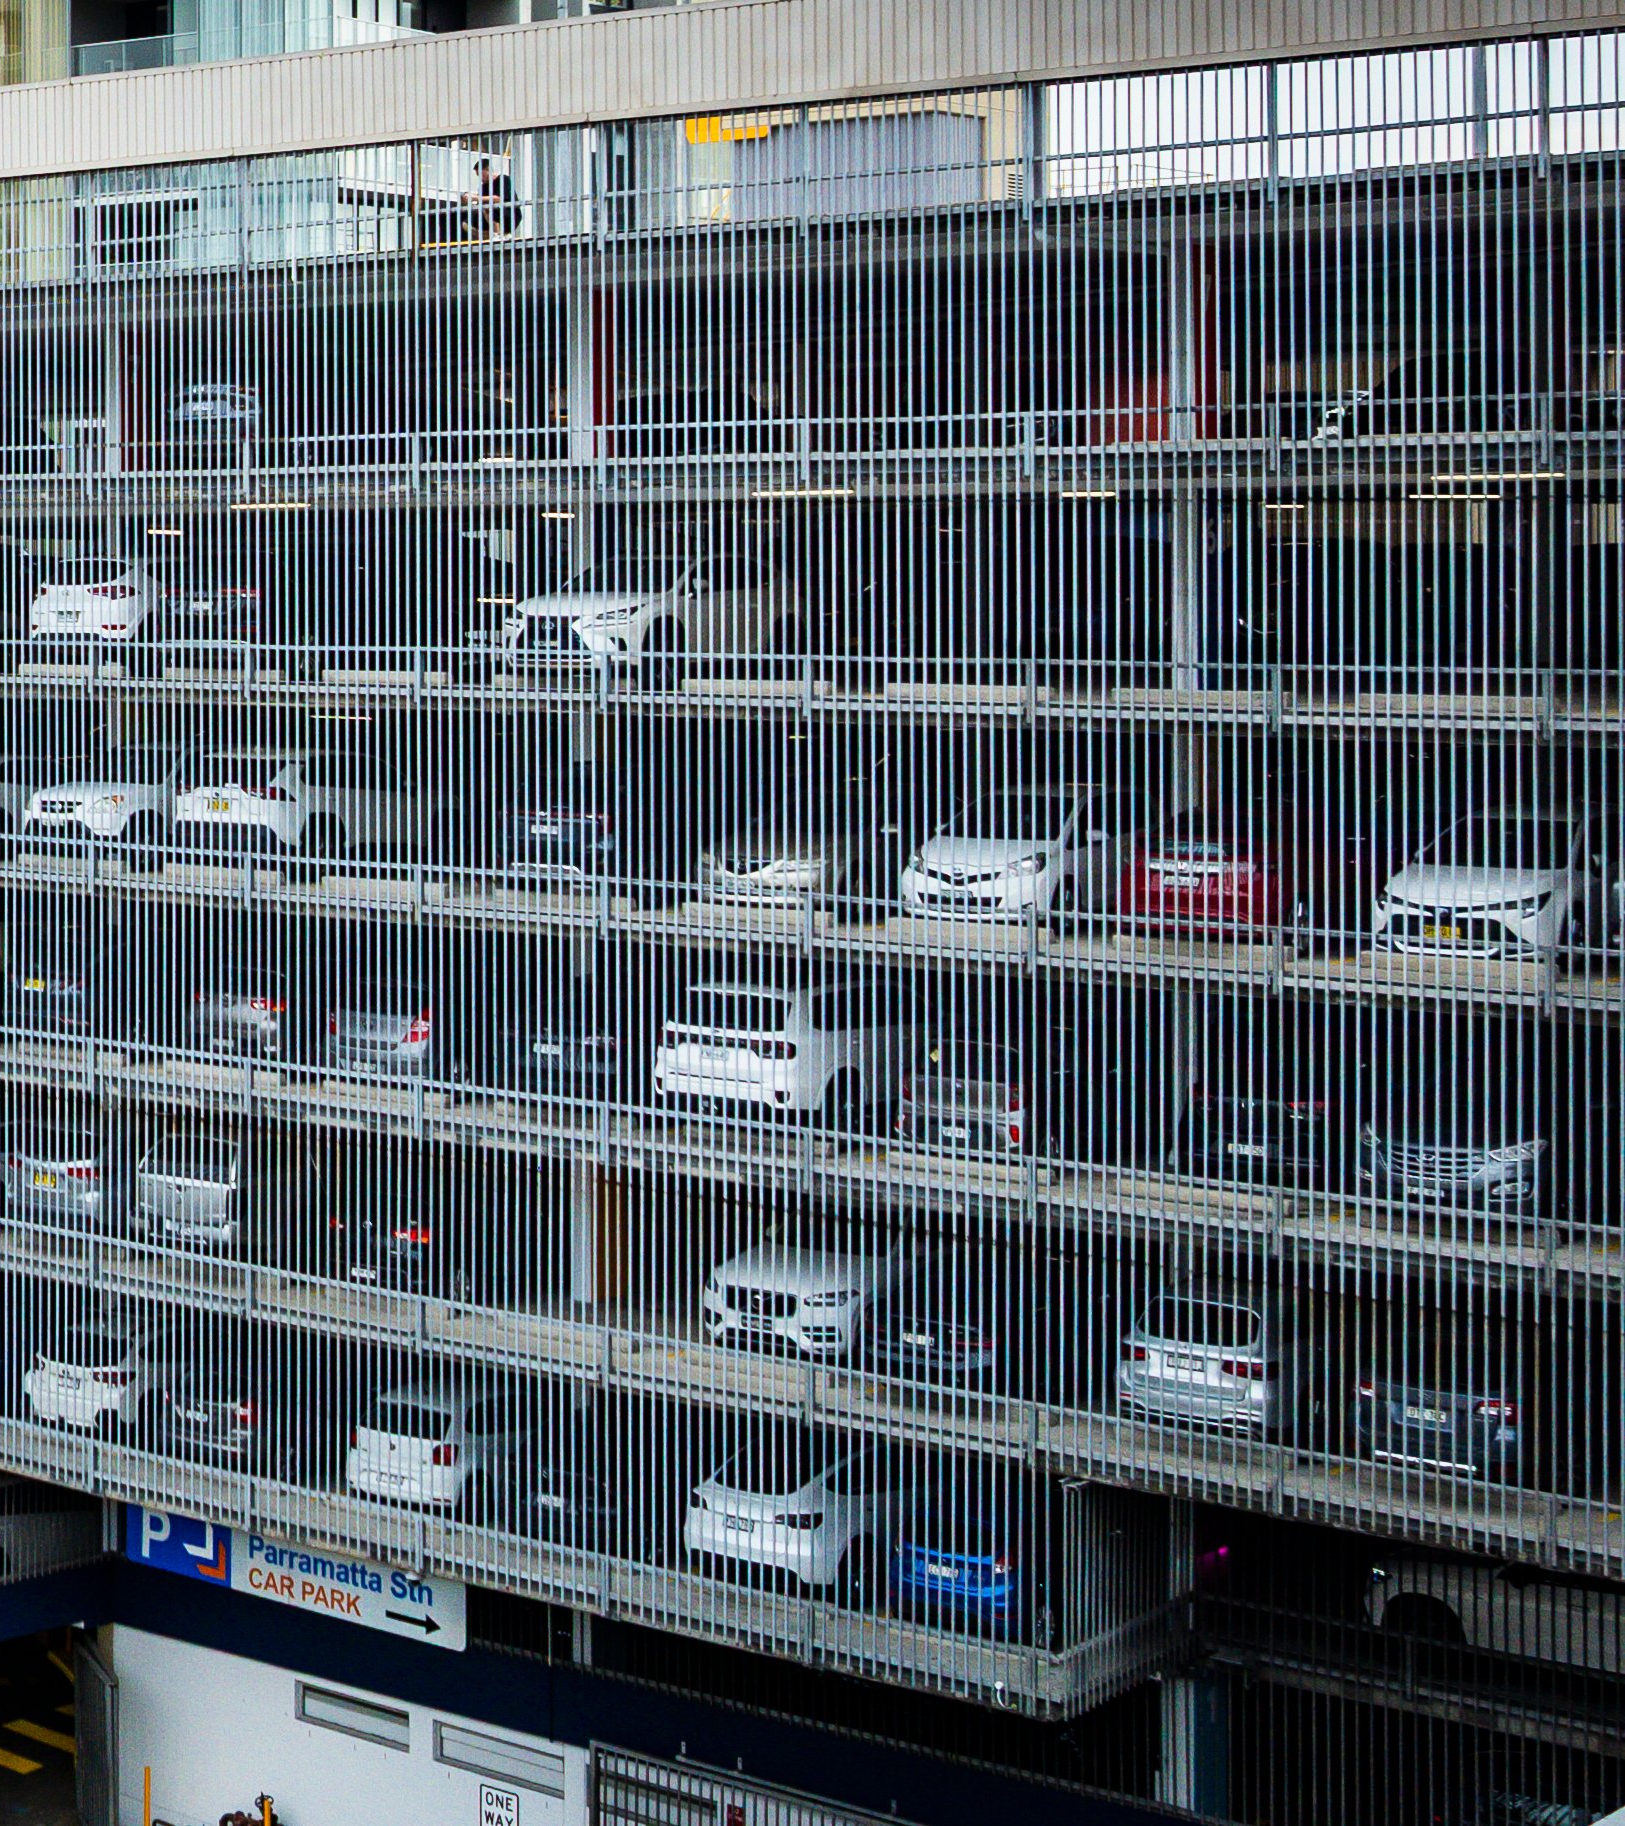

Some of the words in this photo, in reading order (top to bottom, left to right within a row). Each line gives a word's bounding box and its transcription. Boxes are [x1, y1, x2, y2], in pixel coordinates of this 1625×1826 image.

[141, 1511, 171, 1558] P
[249, 1535, 383, 1593] Parramatta
[248, 1568, 295, 1598] CAR
[301, 1582, 362, 1616] PARK
[485, 1792, 513, 1812] ONE
[485, 1810, 513, 1826] WAY
